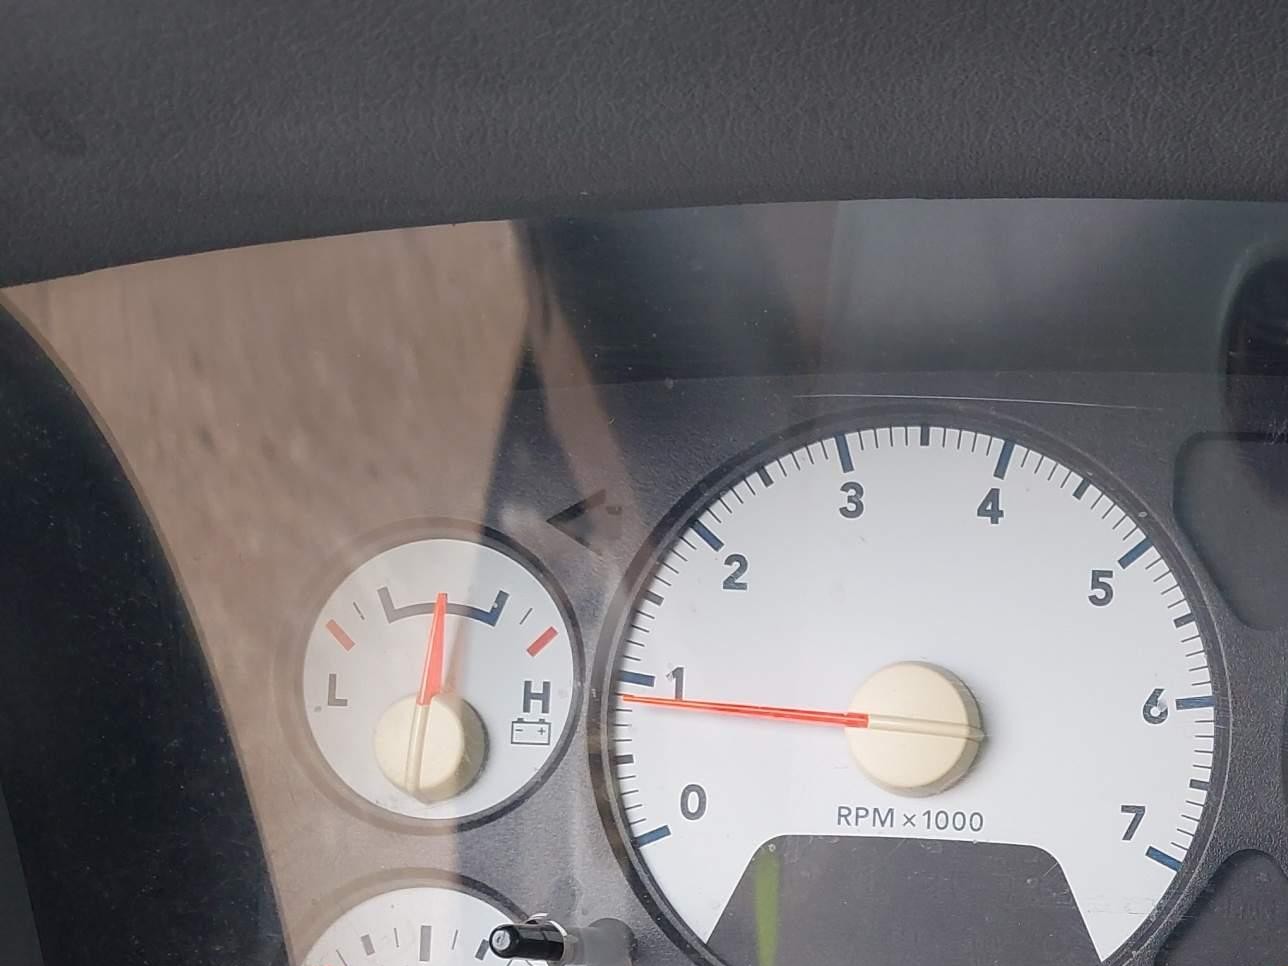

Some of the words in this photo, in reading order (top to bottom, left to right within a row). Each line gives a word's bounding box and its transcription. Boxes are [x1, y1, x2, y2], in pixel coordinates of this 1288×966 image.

[839, 482, 863, 518] 3
[977, 488, 1004, 524] 4
[723, 554, 748, 590] 2
[1088, 570, 1113, 606] 5
[328, 674, 348, 706] L
[523, 681, 550, 713] H
[666, 667, 684, 701] 1
[1143, 689, 1168, 724] 6
[681, 784, 706, 820] 0
[837, 806, 895, 829] RPM
[1121, 805, 1145, 840] 7
